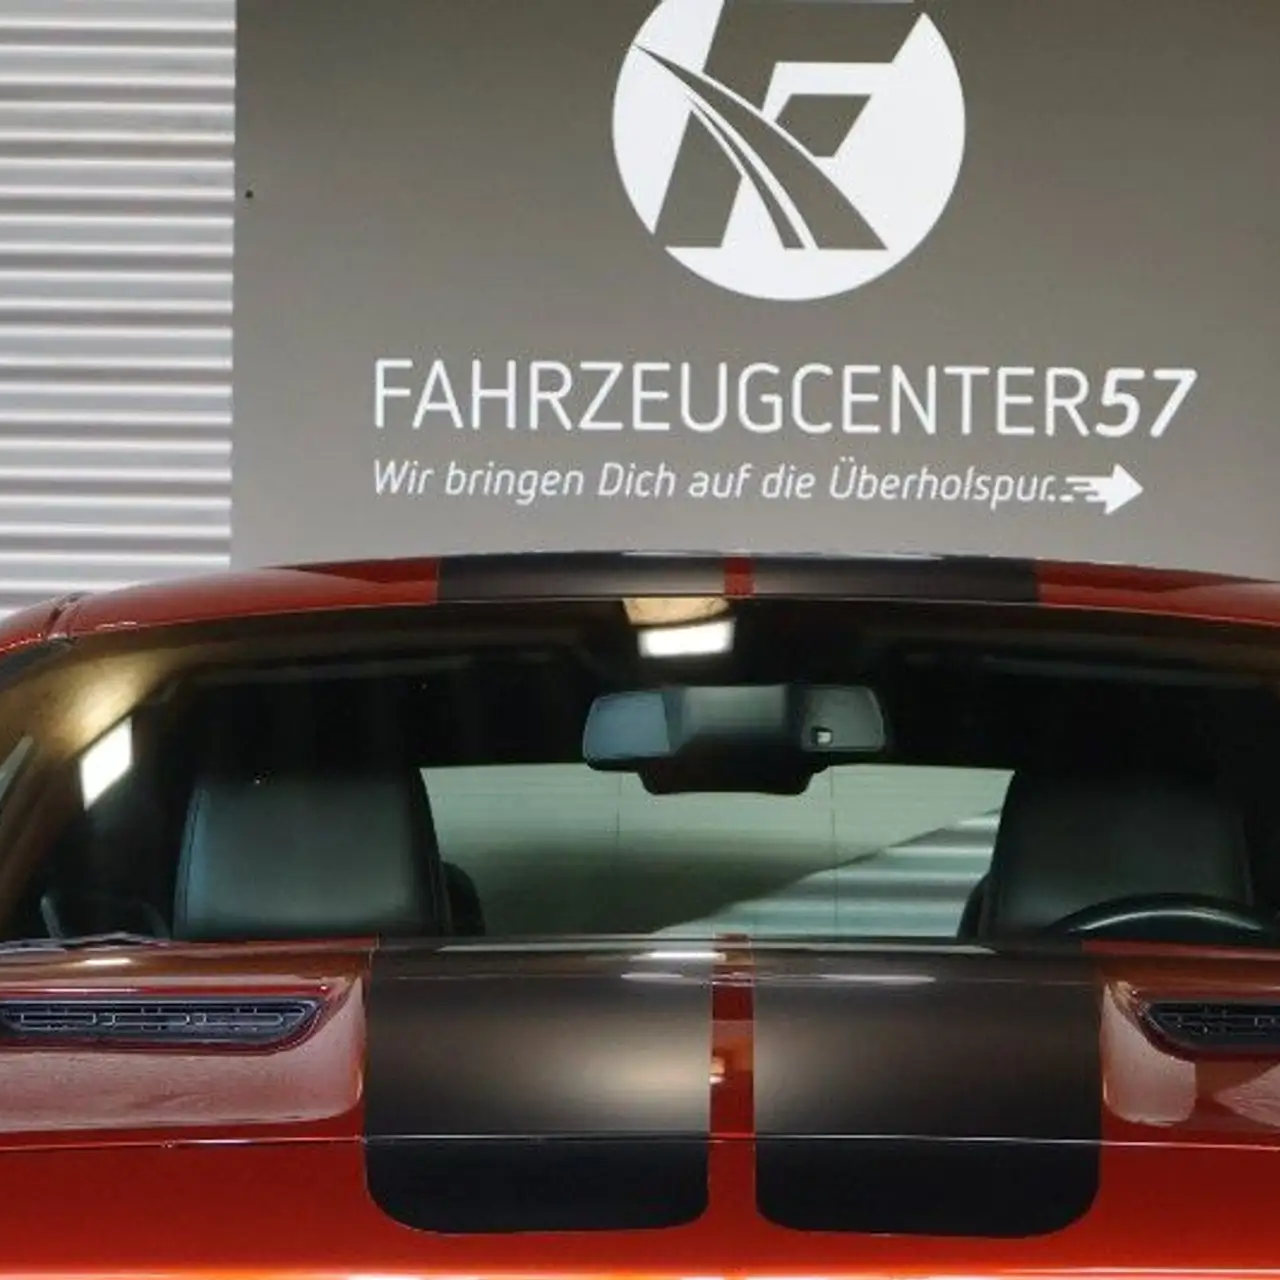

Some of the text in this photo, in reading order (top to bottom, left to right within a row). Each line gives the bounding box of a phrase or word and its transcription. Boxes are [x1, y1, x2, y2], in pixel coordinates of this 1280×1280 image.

[373, 358, 1197, 438] FAHRZEUGCENTER57
[373, 458, 434, 497] Wir
[445, 461, 585, 505] bringen
[598, 462, 677, 499] Dich
[688, 463, 752, 499] auf
[762, 464, 817, 500] die
